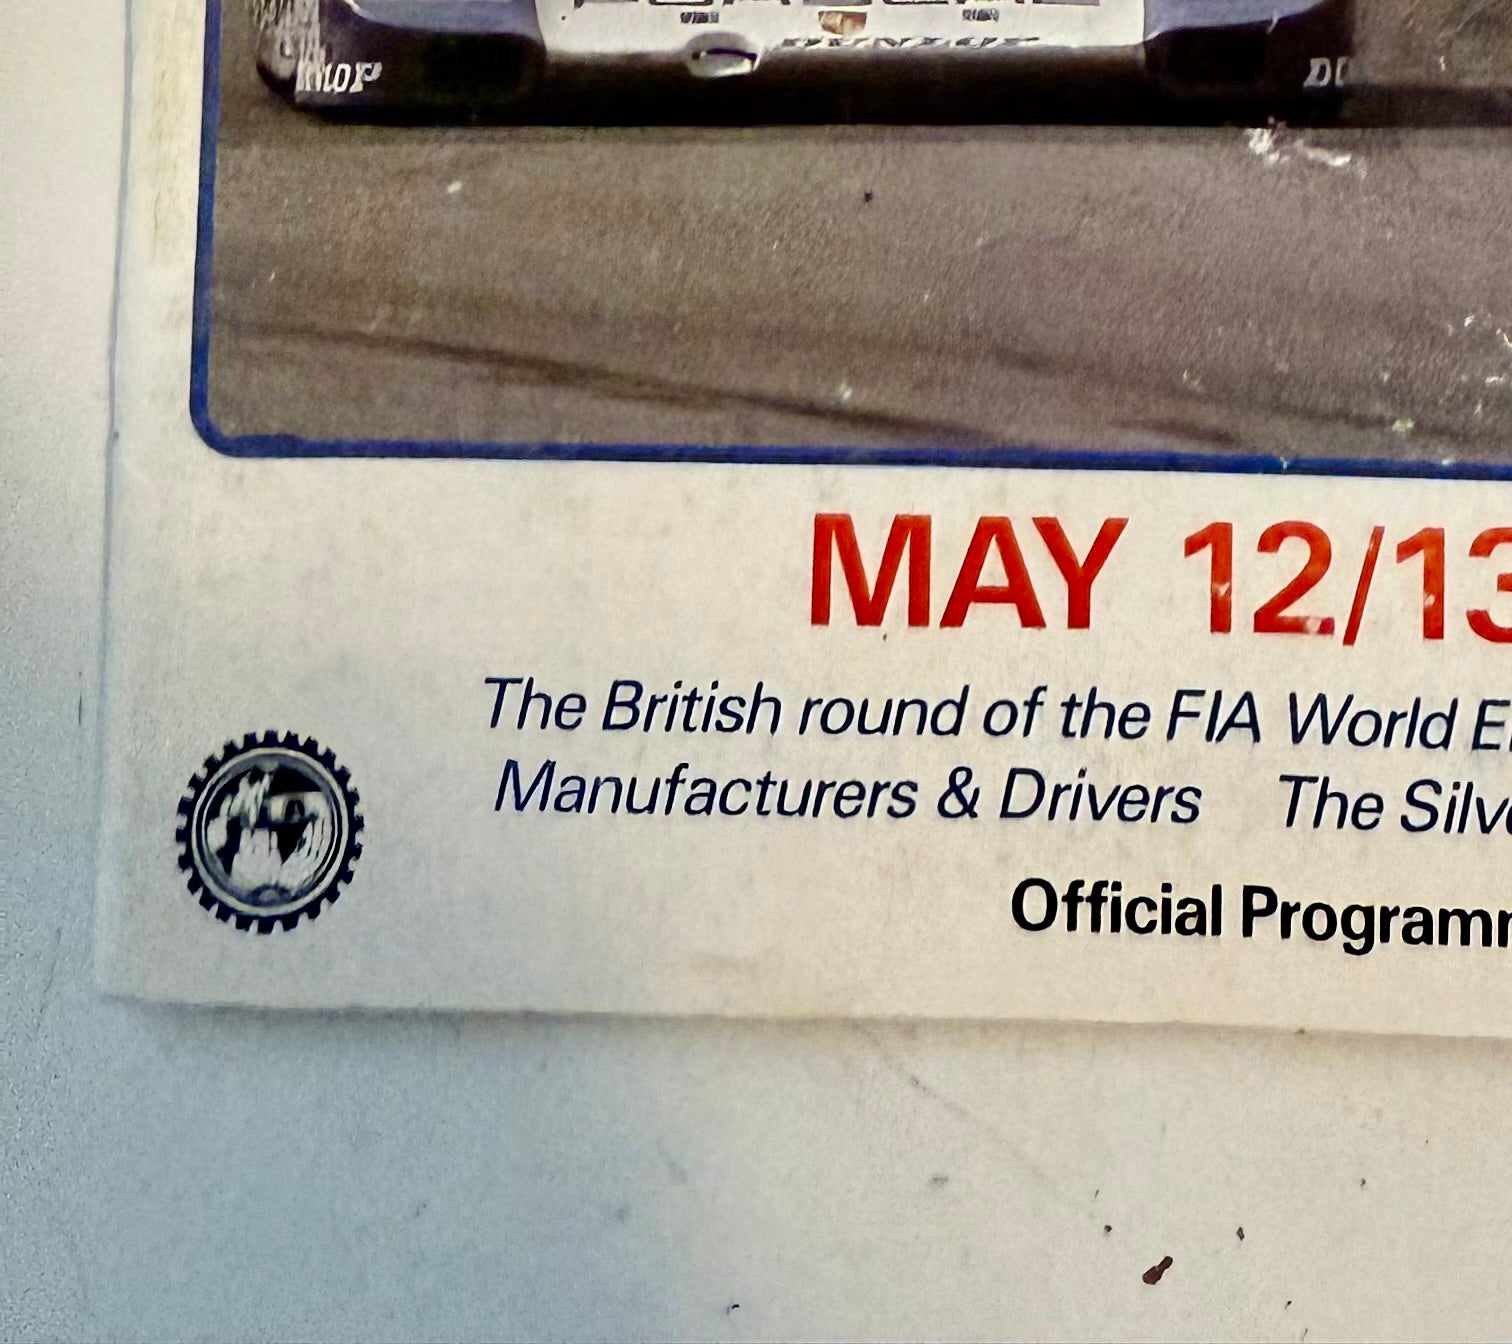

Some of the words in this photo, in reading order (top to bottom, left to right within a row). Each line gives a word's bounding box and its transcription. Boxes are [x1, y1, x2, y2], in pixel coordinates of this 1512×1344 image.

[811, 513, 1127, 629] MAY
[485, 677, 586, 730] The
[602, 680, 781, 735] British
[799, 685, 969, 736] round
[984, 686, 1047, 737] of
[1061, 687, 1150, 739] the
[1167, 690, 1260, 743] FIA
[1290, 693, 1458, 750] World
[495, 759, 918, 818] Manufacturers
[938, 767, 979, 818] &
[1000, 768, 1201, 823] Drivers
[1279, 775, 1383, 830] The
[1012, 878, 1222, 936] Official
